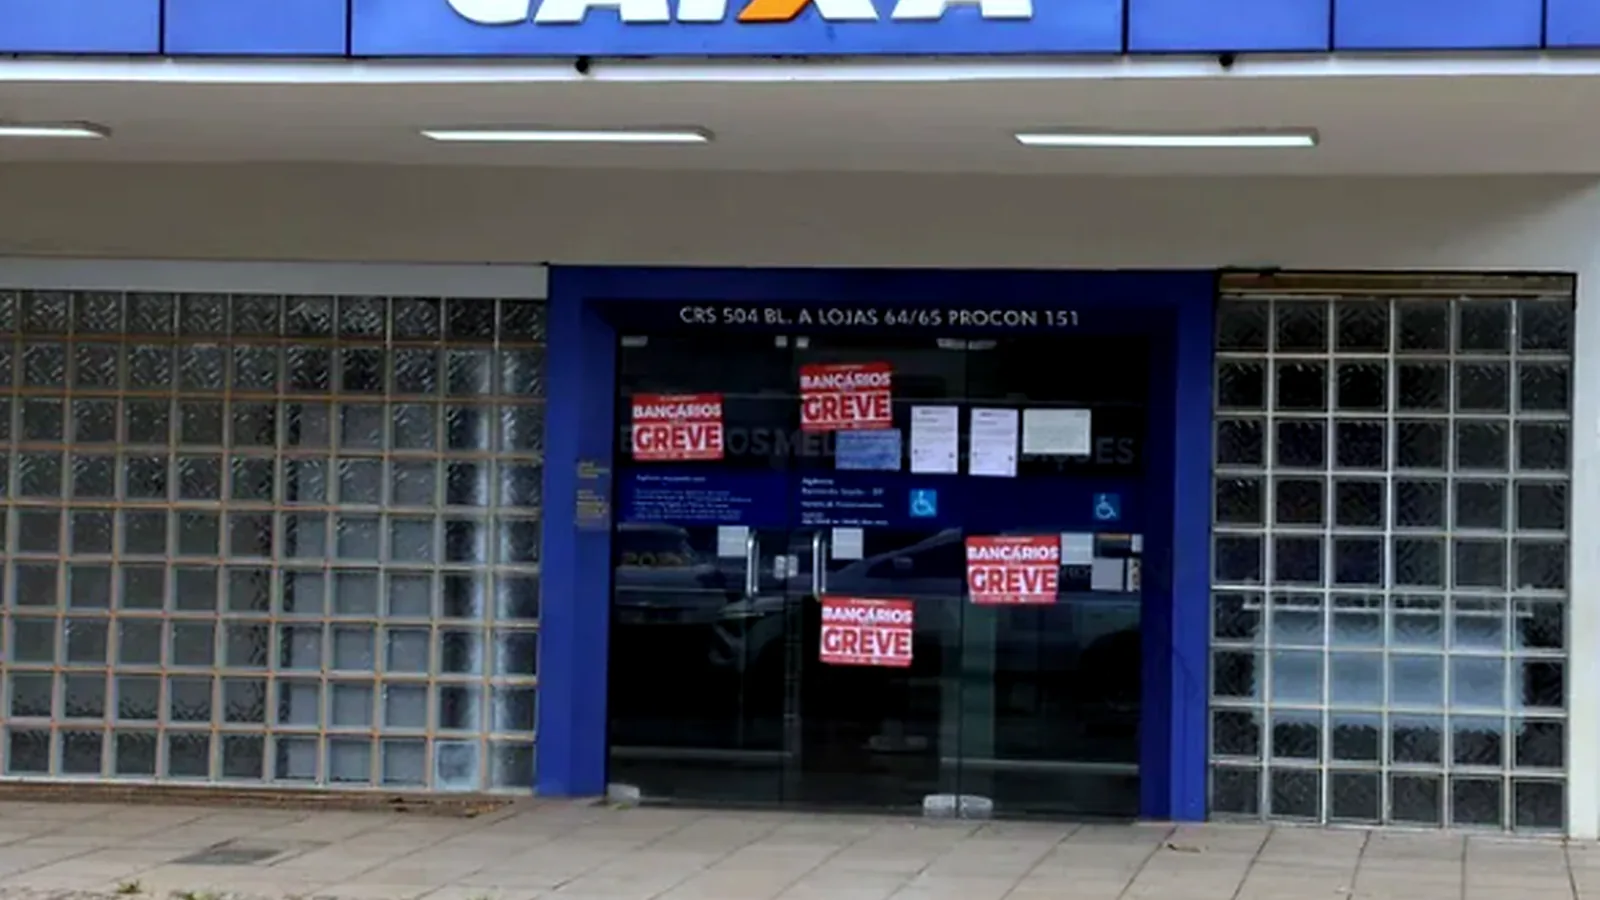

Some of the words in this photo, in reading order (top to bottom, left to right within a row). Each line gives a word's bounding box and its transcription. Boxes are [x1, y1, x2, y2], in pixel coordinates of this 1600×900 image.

[680, 307, 717, 324] CRS
[723, 308, 759, 324] 504
[764, 309, 792, 325] BL.
[799, 309, 812, 324] A
[819, 309, 878, 325] LOJAS
[884, 309, 942, 326] 64/65
[948, 310, 1037, 326] PROCON
[1045, 310, 1079, 326] 151
[801, 371, 891, 388] BANCÁRIOS
[632, 403, 721, 418] BANCÁRIOS
[803, 395, 889, 420] GREVE
[636, 426, 720, 450] GREVE
[966, 545, 1059, 560] BANCÁRIOS
[970, 568, 1057, 592] GREVE
[822, 606, 912, 623] BANCÁRIOS
[824, 629, 910, 655] GREVE
